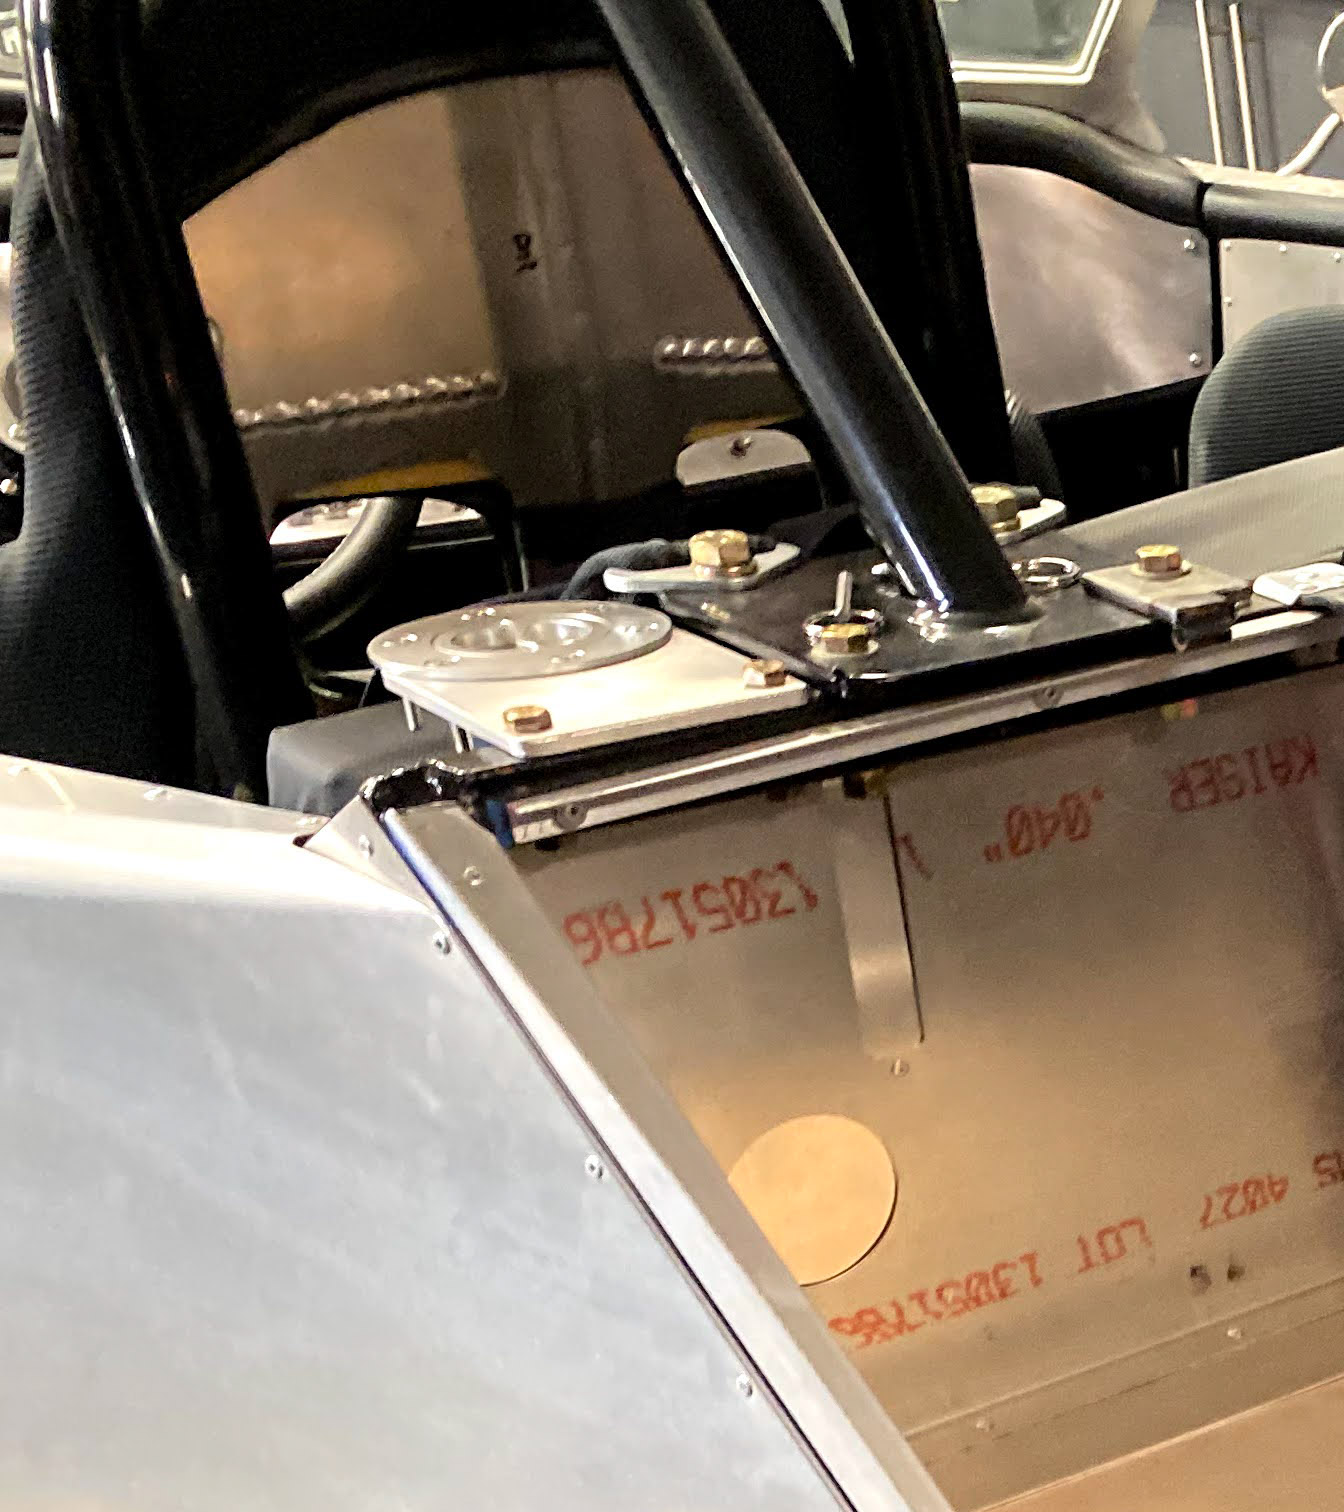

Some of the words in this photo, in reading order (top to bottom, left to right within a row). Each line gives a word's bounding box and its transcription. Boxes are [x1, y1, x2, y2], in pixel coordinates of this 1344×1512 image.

[1164, 736, 1320, 812] KAISER
[1199, 1172, 1292, 1230] 4027
[1074, 1214, 1154, 1275] LOT
